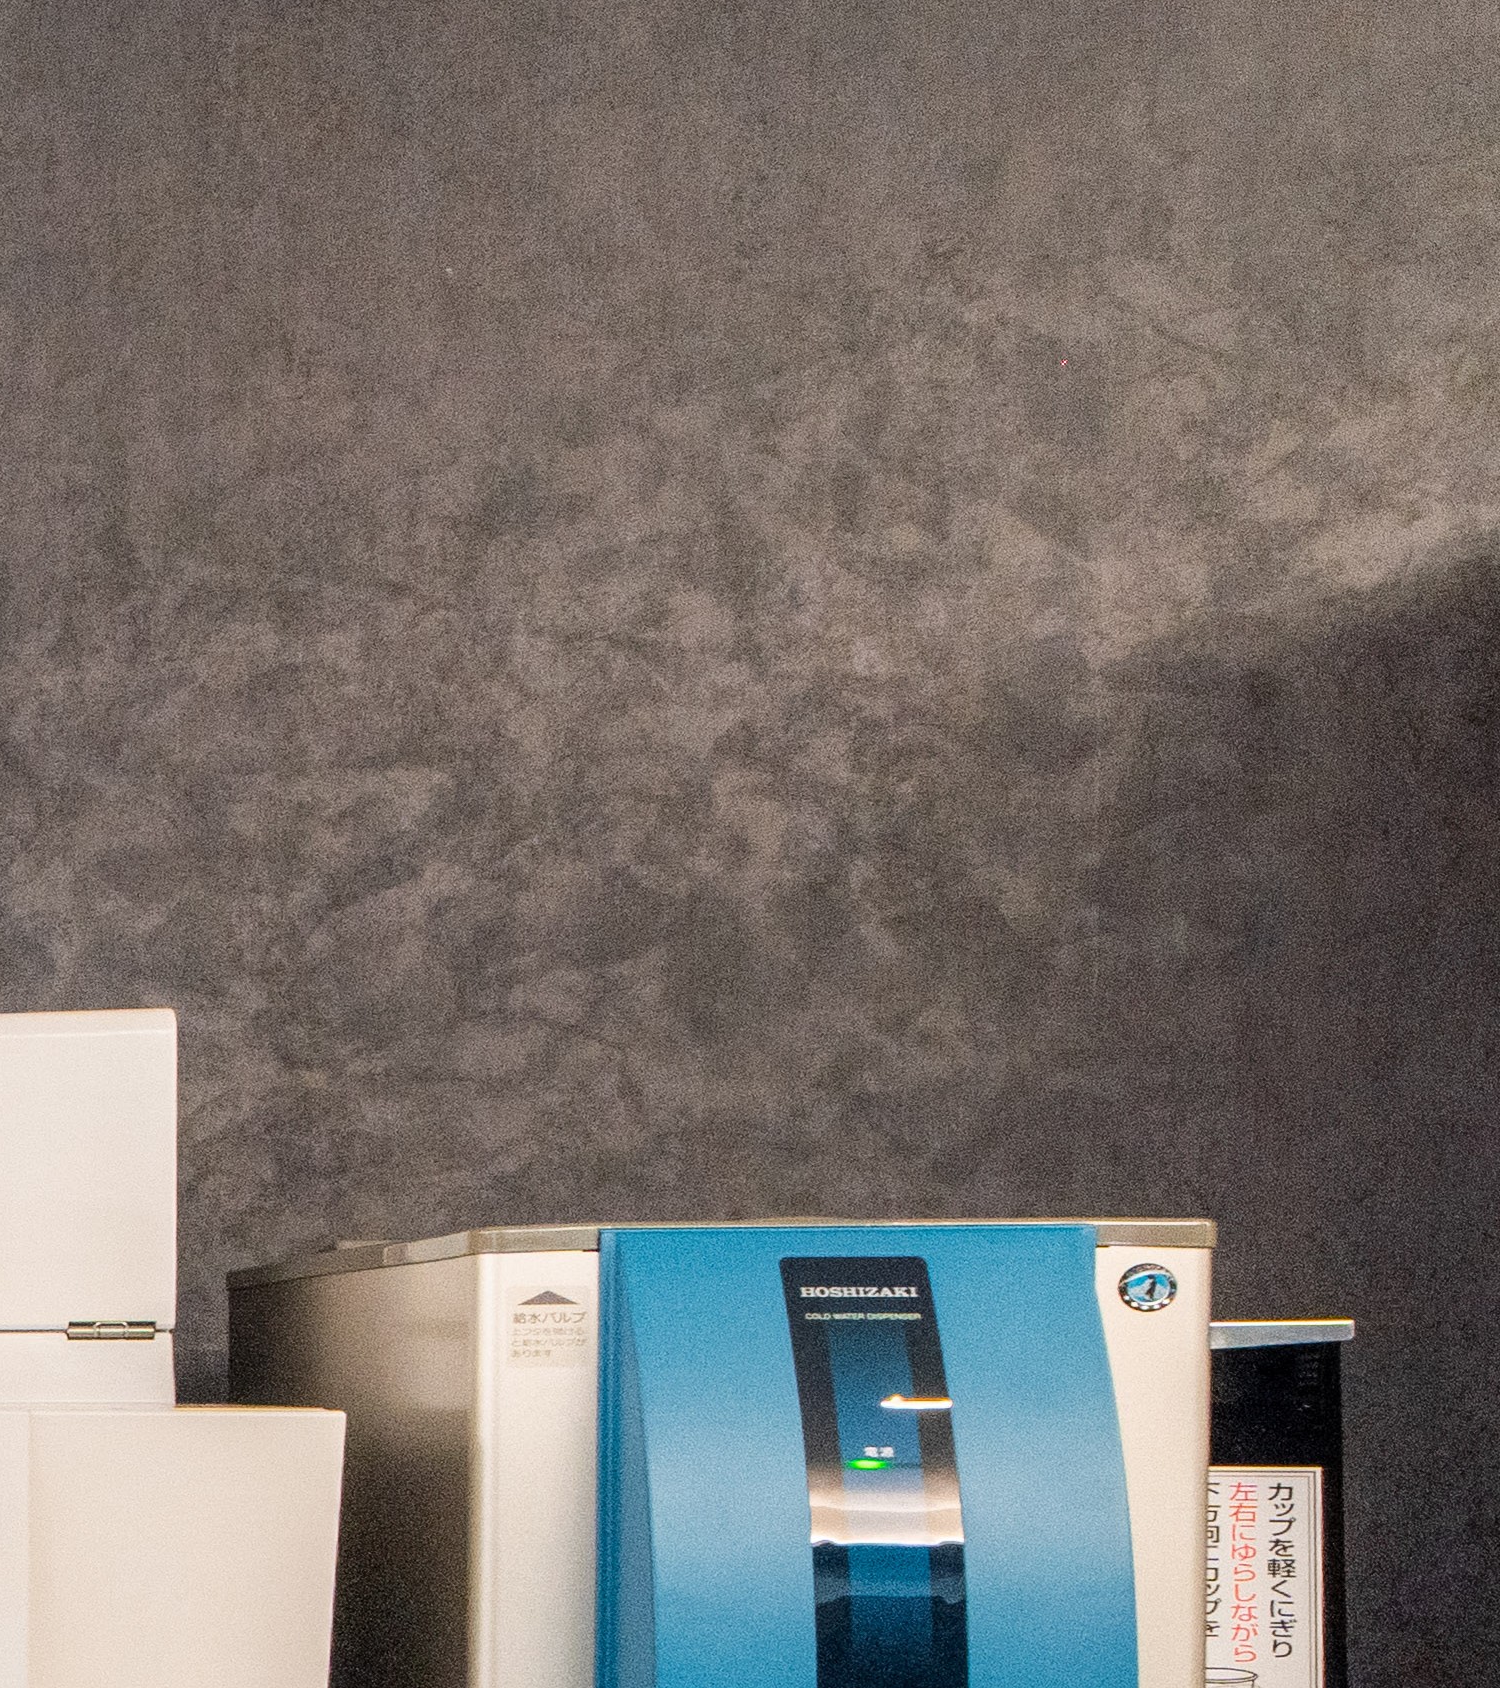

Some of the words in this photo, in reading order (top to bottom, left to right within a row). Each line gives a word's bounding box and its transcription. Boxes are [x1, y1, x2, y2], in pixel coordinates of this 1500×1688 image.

[801, 1286, 920, 1298] HOSHIZAKI
[1229, 1482, 1258, 1663] 左右にゆらしながら
[1268, 1483, 1297, 1659] カップを軽くにぎり
